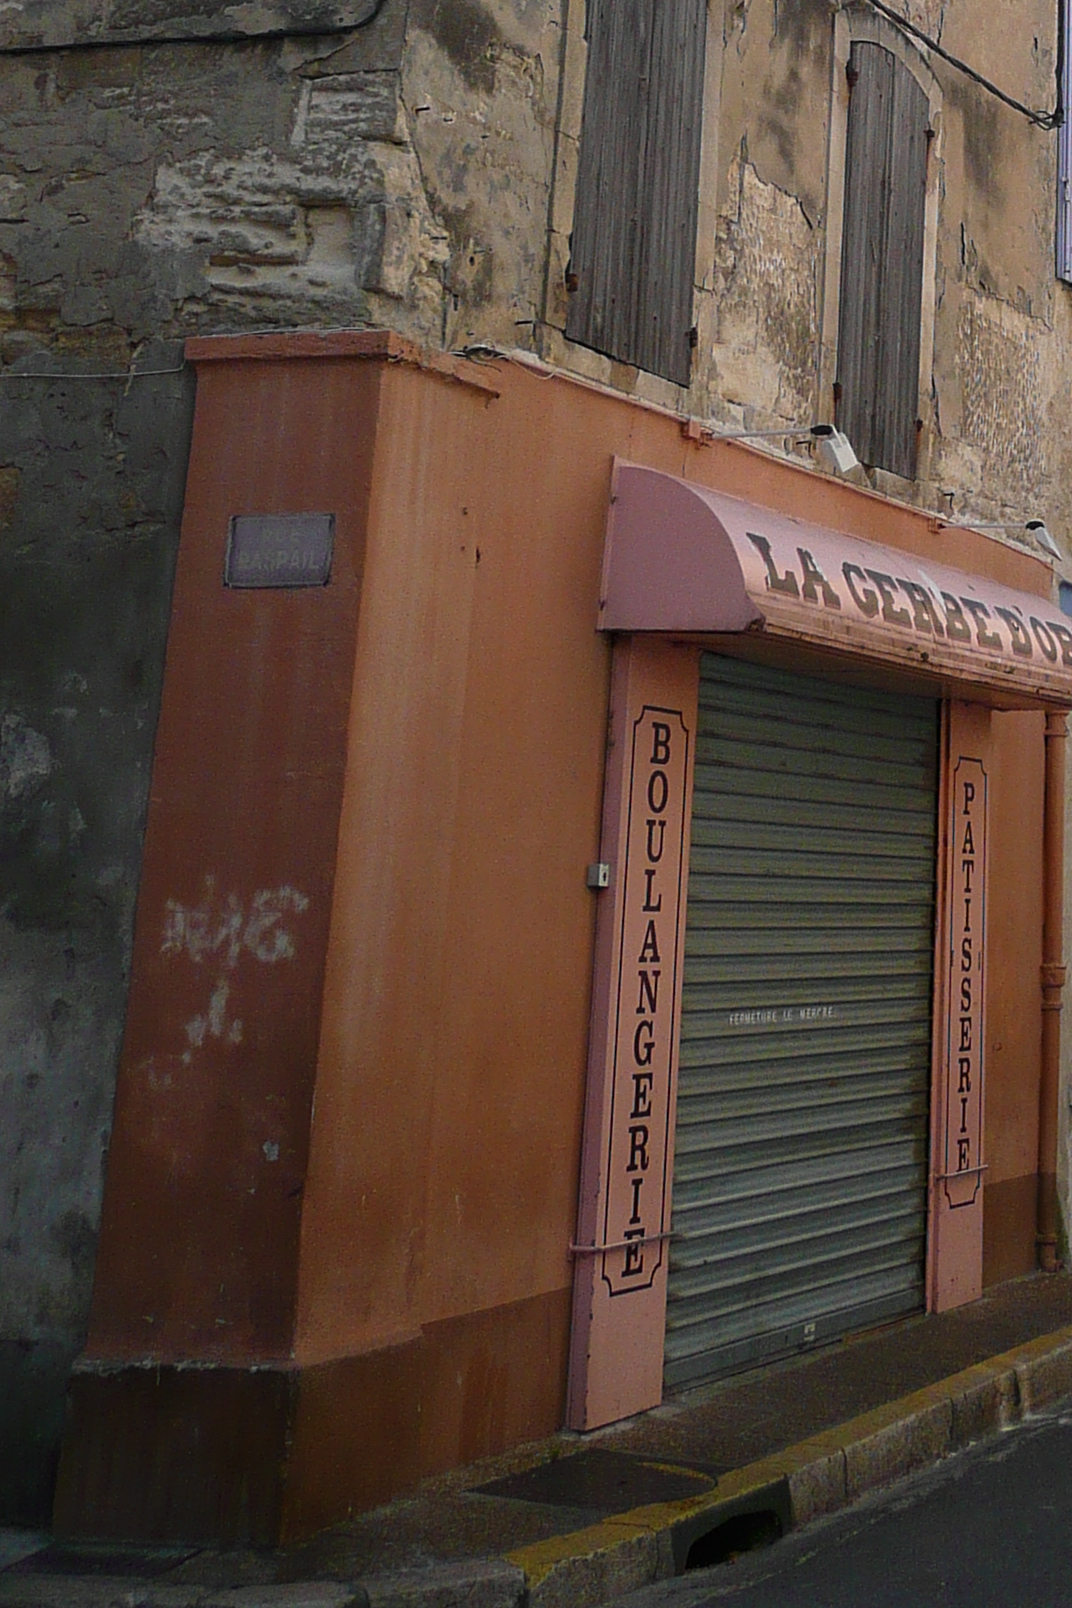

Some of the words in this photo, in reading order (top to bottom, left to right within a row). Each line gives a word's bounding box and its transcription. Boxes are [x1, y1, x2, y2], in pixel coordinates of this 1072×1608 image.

[746, 531, 842, 610] LA
[841, 561, 1004, 651] GERBE
[620, 721, 671, 1278] BOULANGERIE
[955, 781, 975, 1173] PATISSERIE
